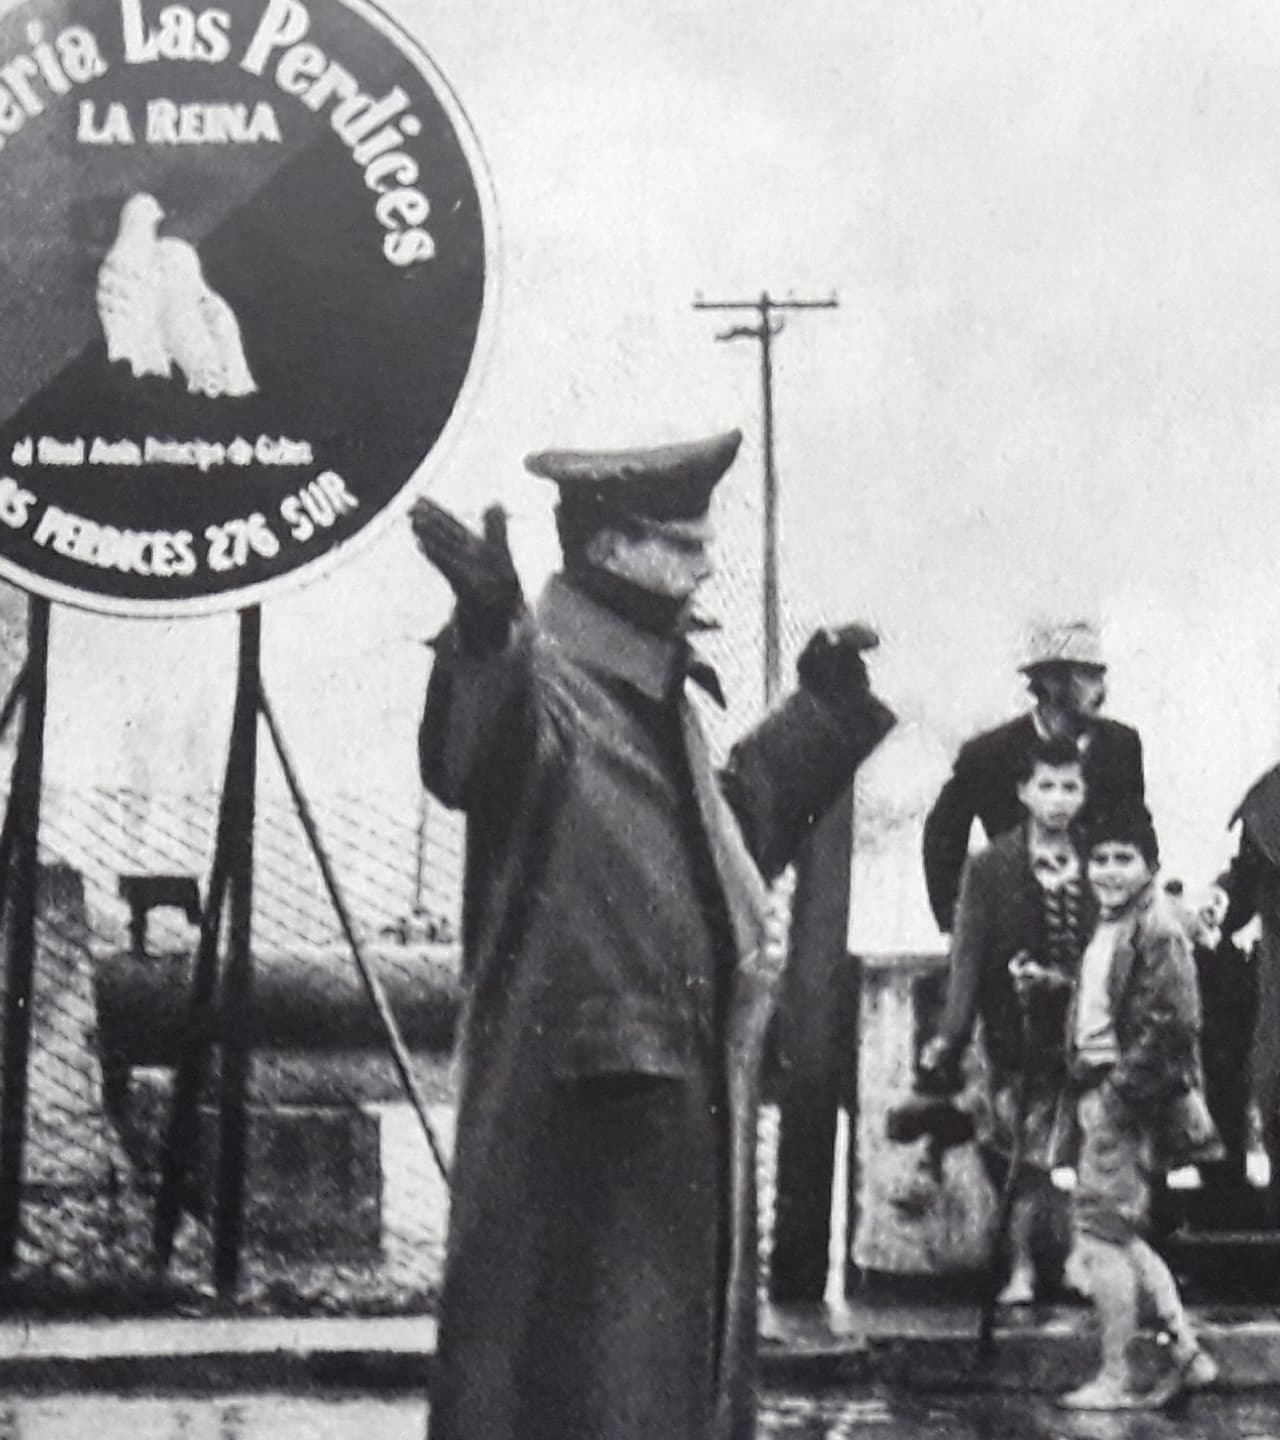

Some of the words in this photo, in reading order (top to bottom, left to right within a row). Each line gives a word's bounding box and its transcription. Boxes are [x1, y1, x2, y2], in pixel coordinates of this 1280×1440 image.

[76, 98, 136, 145] LA
[145, 97, 282, 146] REINA
[120, 0, 232, 65] Las
[239, 0, 436, 267] Perdices
[204, 512, 280, 572] 276
[279, 470, 359, 542] SUR
